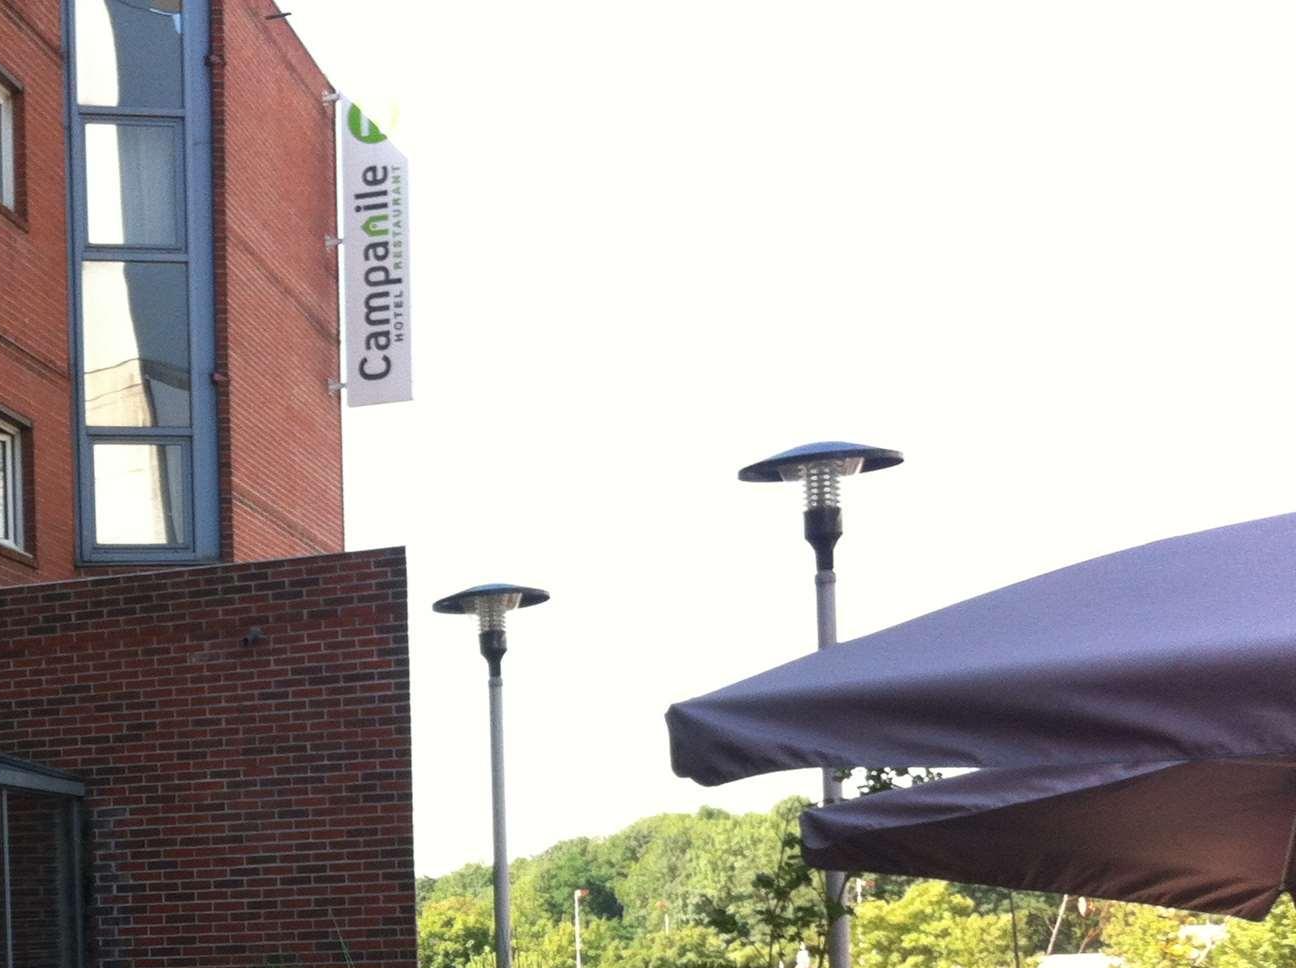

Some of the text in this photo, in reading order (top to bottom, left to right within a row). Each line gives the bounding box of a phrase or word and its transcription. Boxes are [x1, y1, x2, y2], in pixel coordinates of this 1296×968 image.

[354, 165, 403, 382] Campanile
[391, 165, 404, 342] HOTEL RESTAURANT
